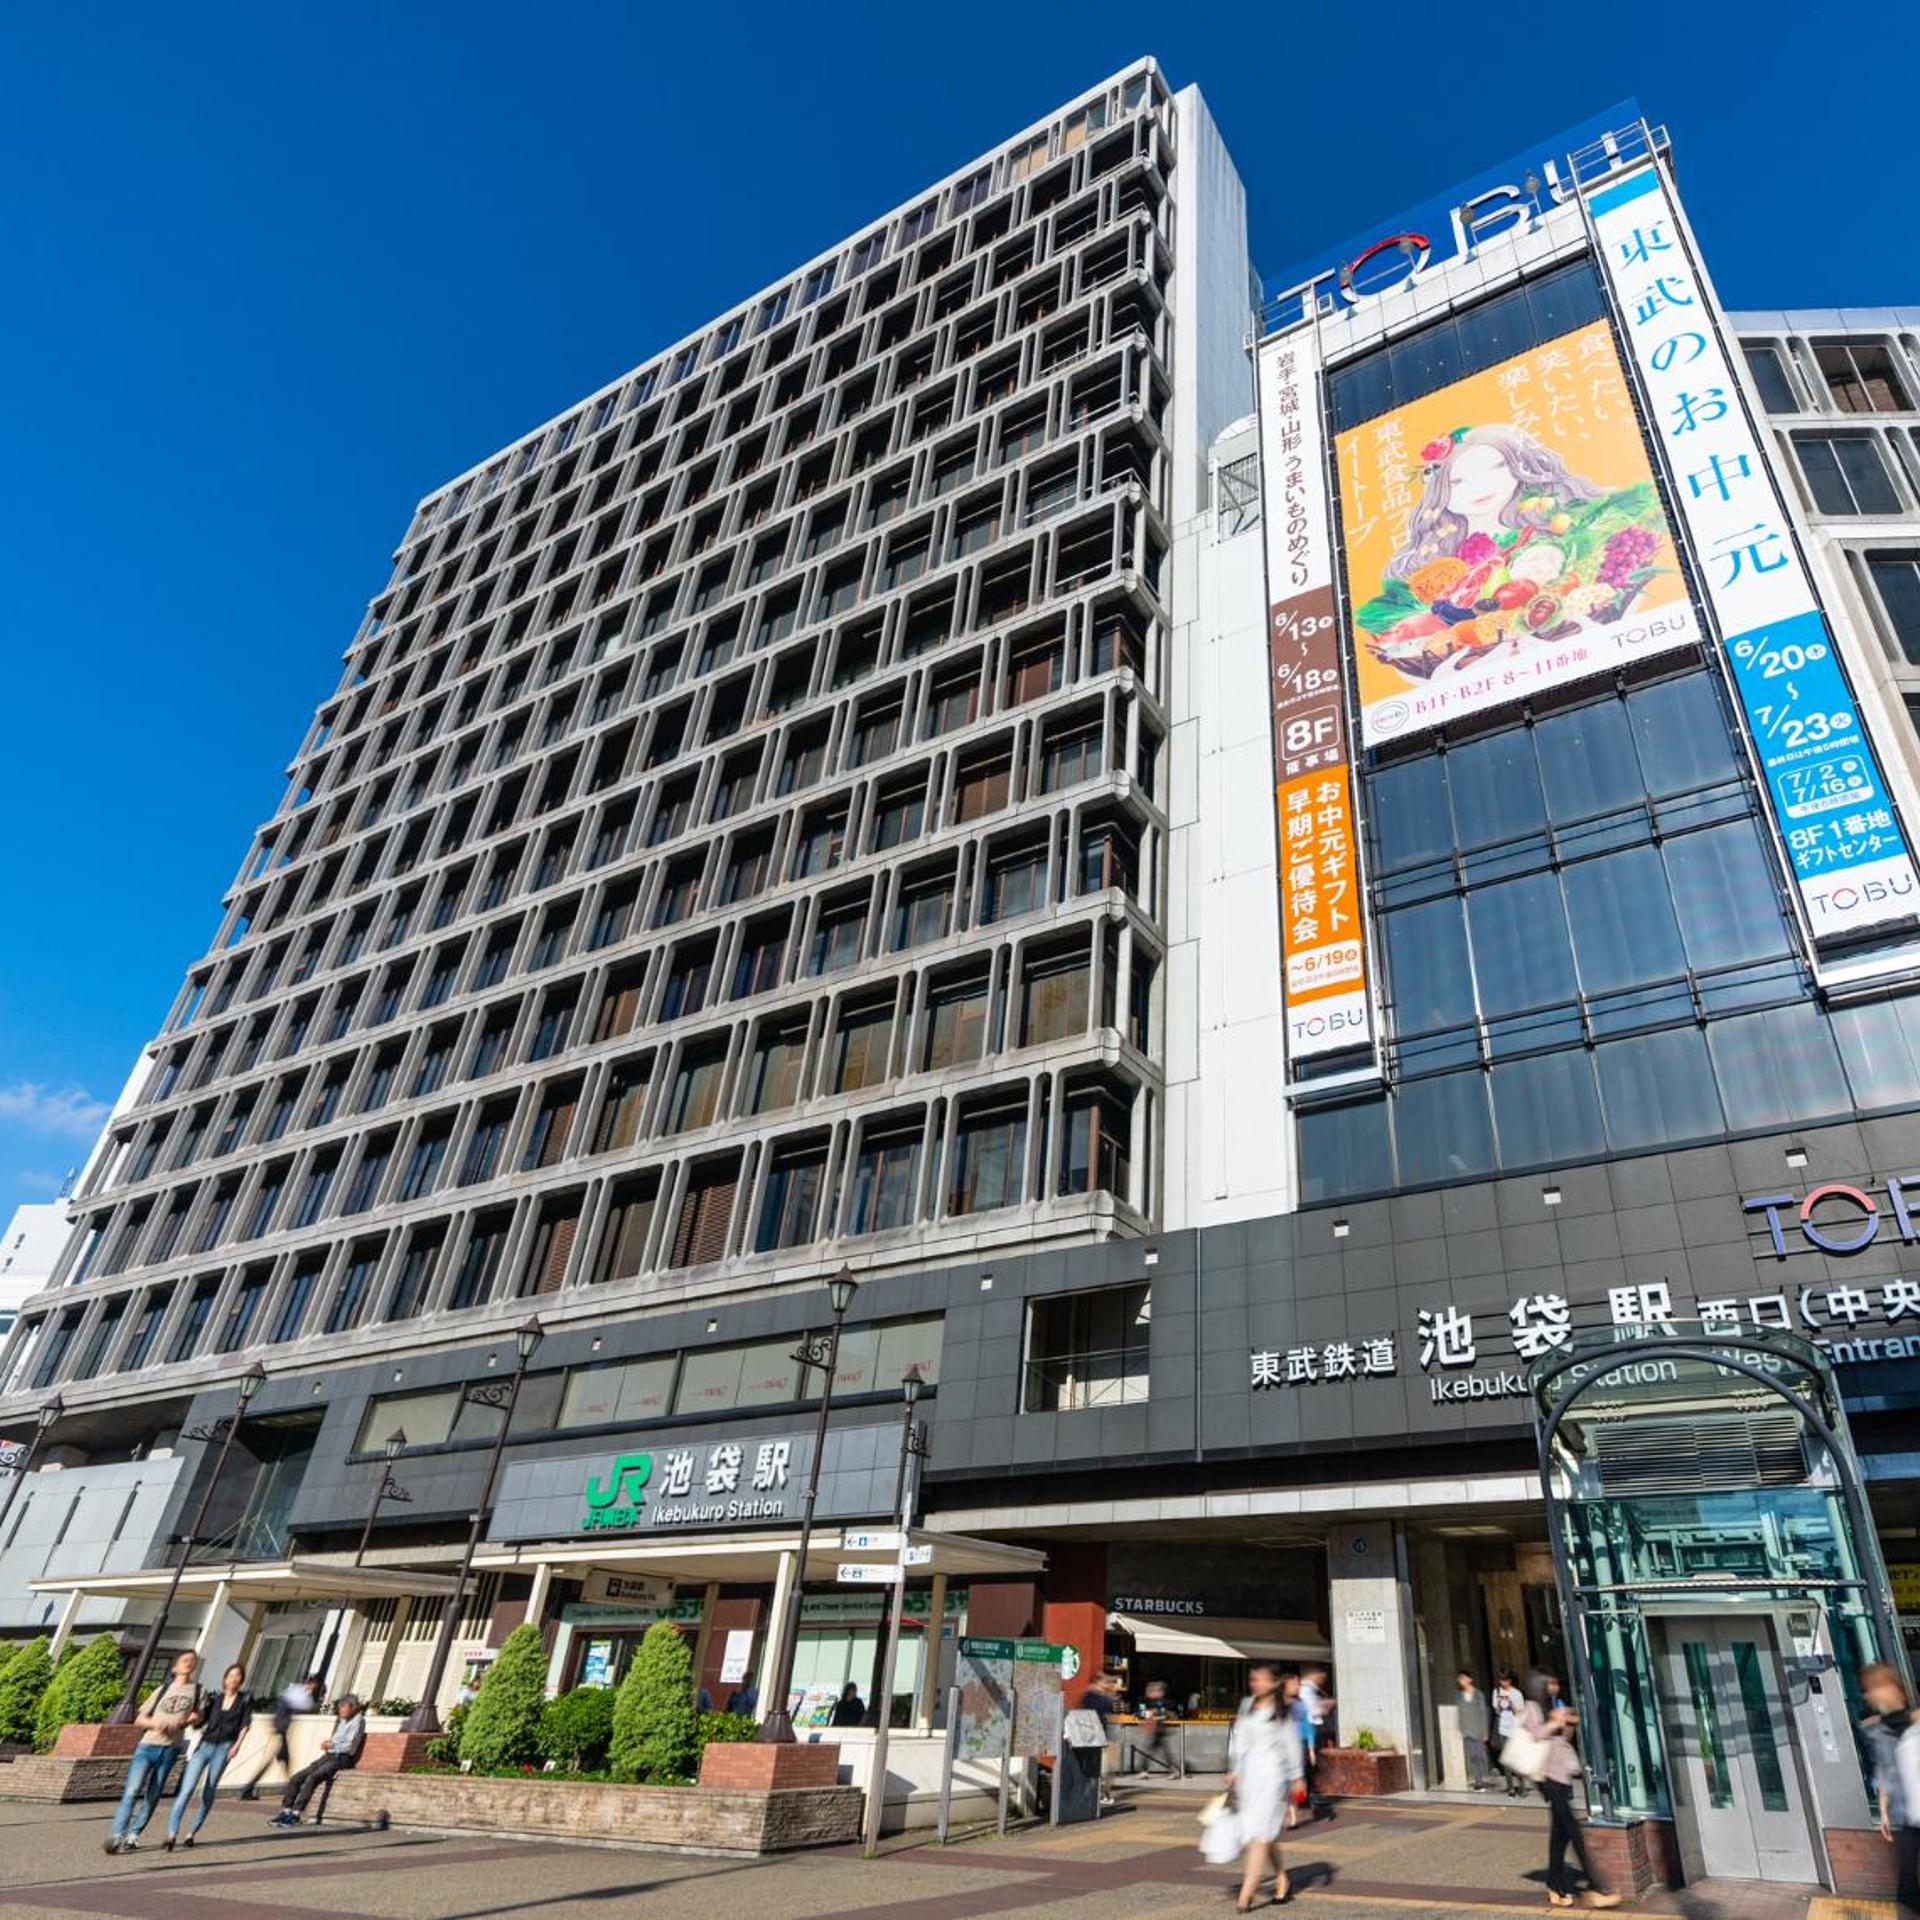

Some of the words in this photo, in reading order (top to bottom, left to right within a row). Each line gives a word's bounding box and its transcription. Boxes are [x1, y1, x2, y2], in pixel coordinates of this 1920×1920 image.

[1610, 221, 1789, 589] 東武のお中元
[1284, 455, 1309, 586] うまいものめぐり
[1611, 614, 1687, 648] TOBU
[1286, 716, 1334, 752] 8F
[1789, 824, 1824, 850] 8F
[1797, 833, 1898, 869] ギフトセンター
[1286, 788, 1319, 945] 早期ご優待会
[1316, 781, 1350, 932] お中元ギフト
[1812, 874, 1913, 914] TOBU
[1292, 1008, 1363, 1039] TOBU
[1250, 1338, 1396, 1386] 東武鉄道
[1417, 1281, 1679, 1367] 池袋駅
[1711, 1348, 1802, 1377] Wes
[586, 1452, 653, 1507] JR
[660, 1442, 791, 1496] 池袋駅
[652, 1502, 724, 1524] Ikebukuro
[726, 1498, 783, 1518] Station
[1114, 1598, 1205, 1614] STARBUCKS
